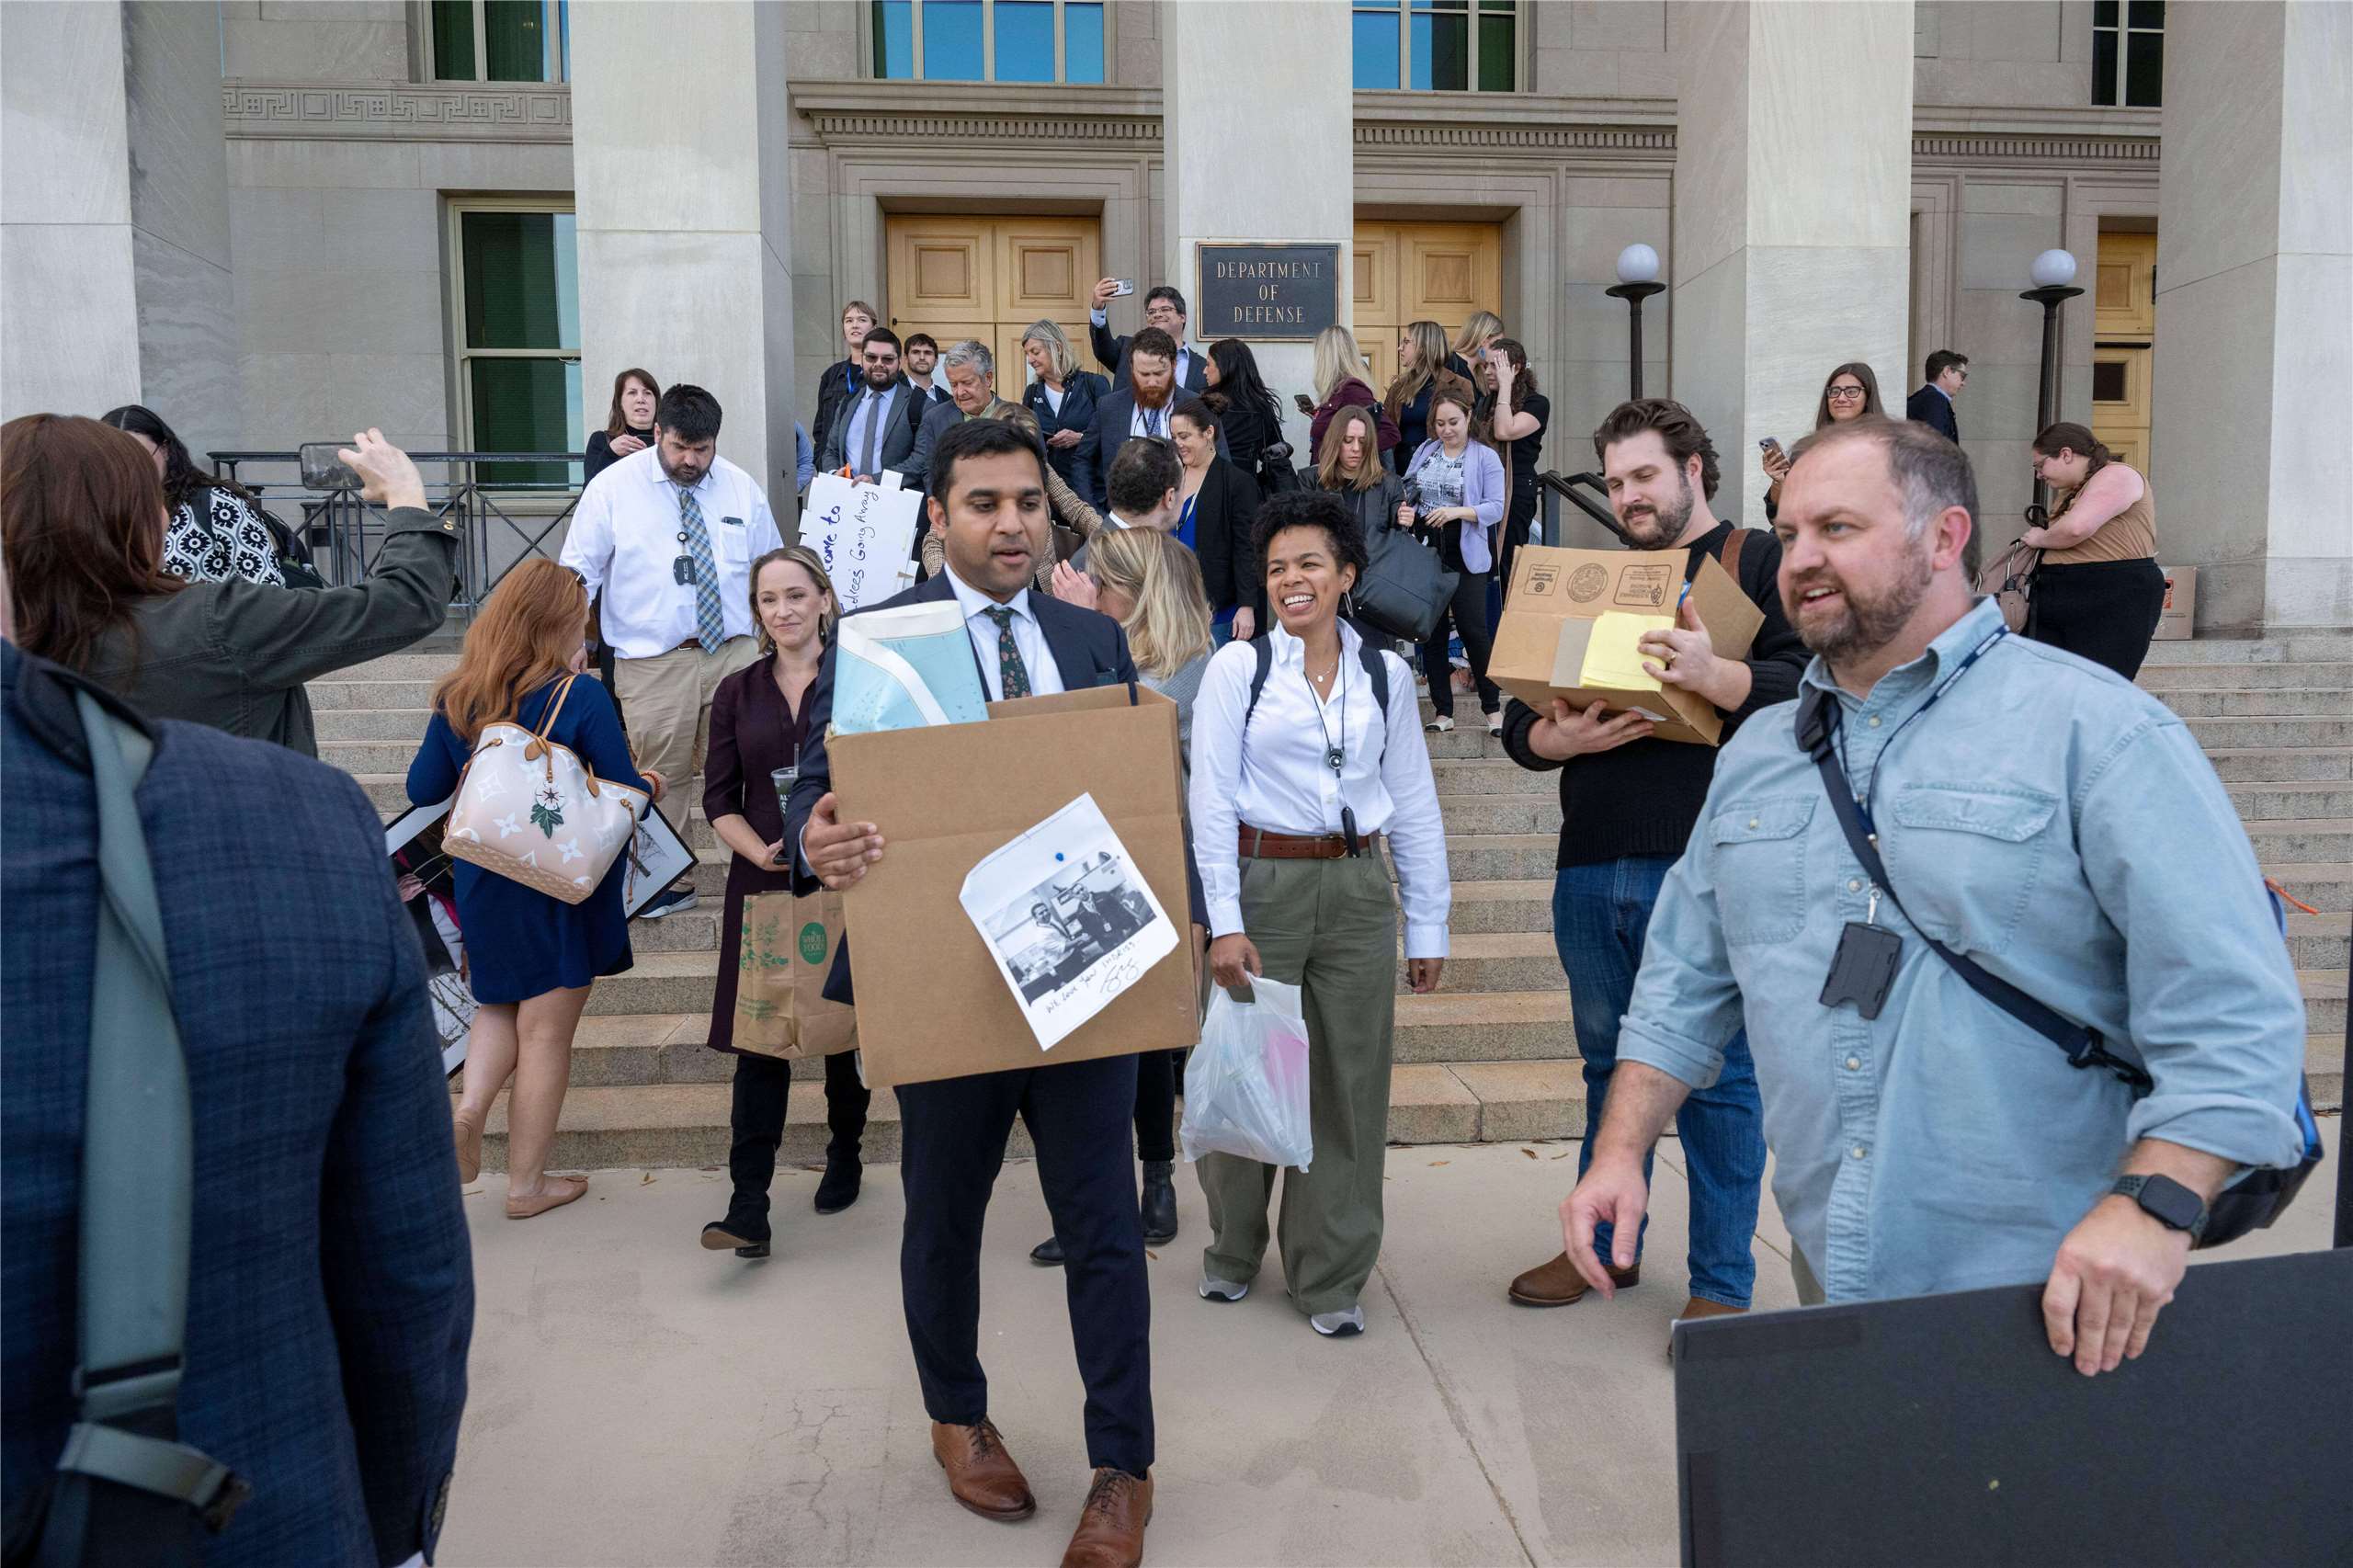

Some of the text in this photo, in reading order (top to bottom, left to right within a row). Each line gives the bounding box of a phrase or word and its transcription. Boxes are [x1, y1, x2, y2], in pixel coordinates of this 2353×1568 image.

[1217, 261, 1322, 278] DEPARTMENT
[1258, 284, 1279, 301] OF
[1233, 306, 1305, 324] DEFENSE
[854, 491, 879, 523] Away
[820, 506, 840, 578] come to
[849, 527, 876, 561] Going
